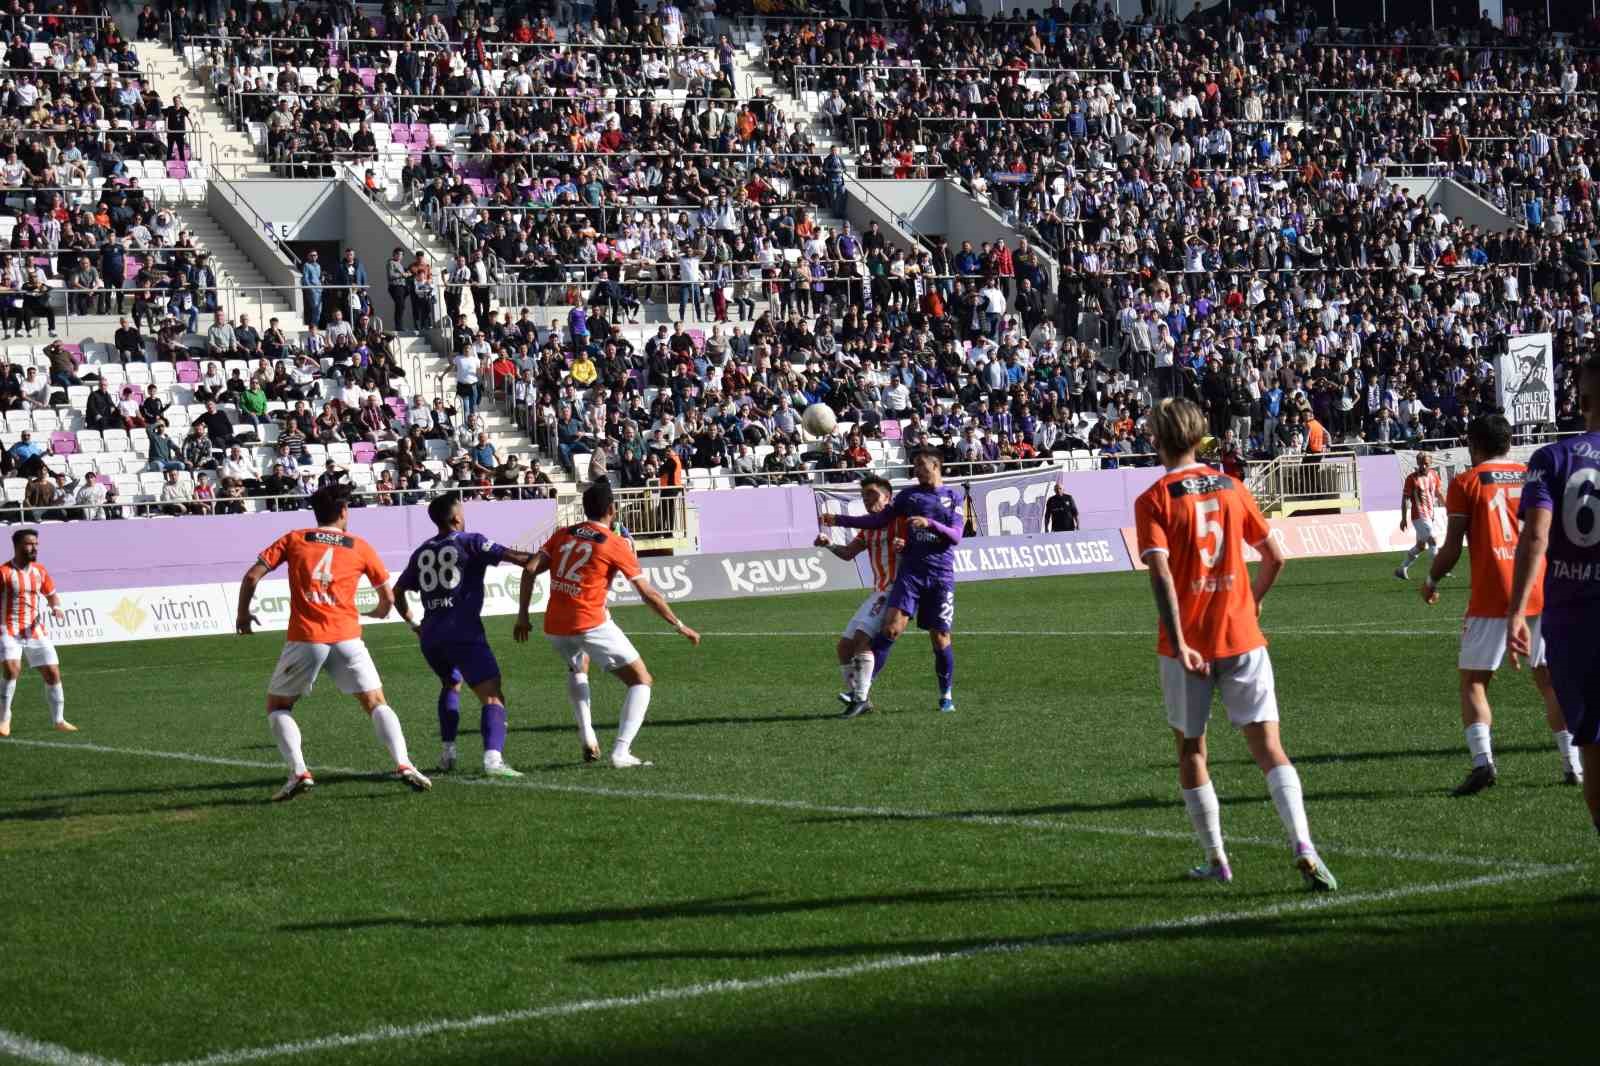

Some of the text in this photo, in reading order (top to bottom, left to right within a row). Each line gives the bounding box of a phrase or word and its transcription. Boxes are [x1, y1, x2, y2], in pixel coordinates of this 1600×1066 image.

[1562, 467, 1600, 547] 6
[1194, 498, 1224, 568] 5
[311, 545, 335, 591] 4
[417, 545, 461, 592] 88
[556, 539, 593, 582] 12
[980, 546, 1034, 572] ALTAŞ
[1034, 540, 1114, 567] COLLEGE
[151, 594, 212, 621] vitrin
[152, 619, 219, 633] KUYUMCU
